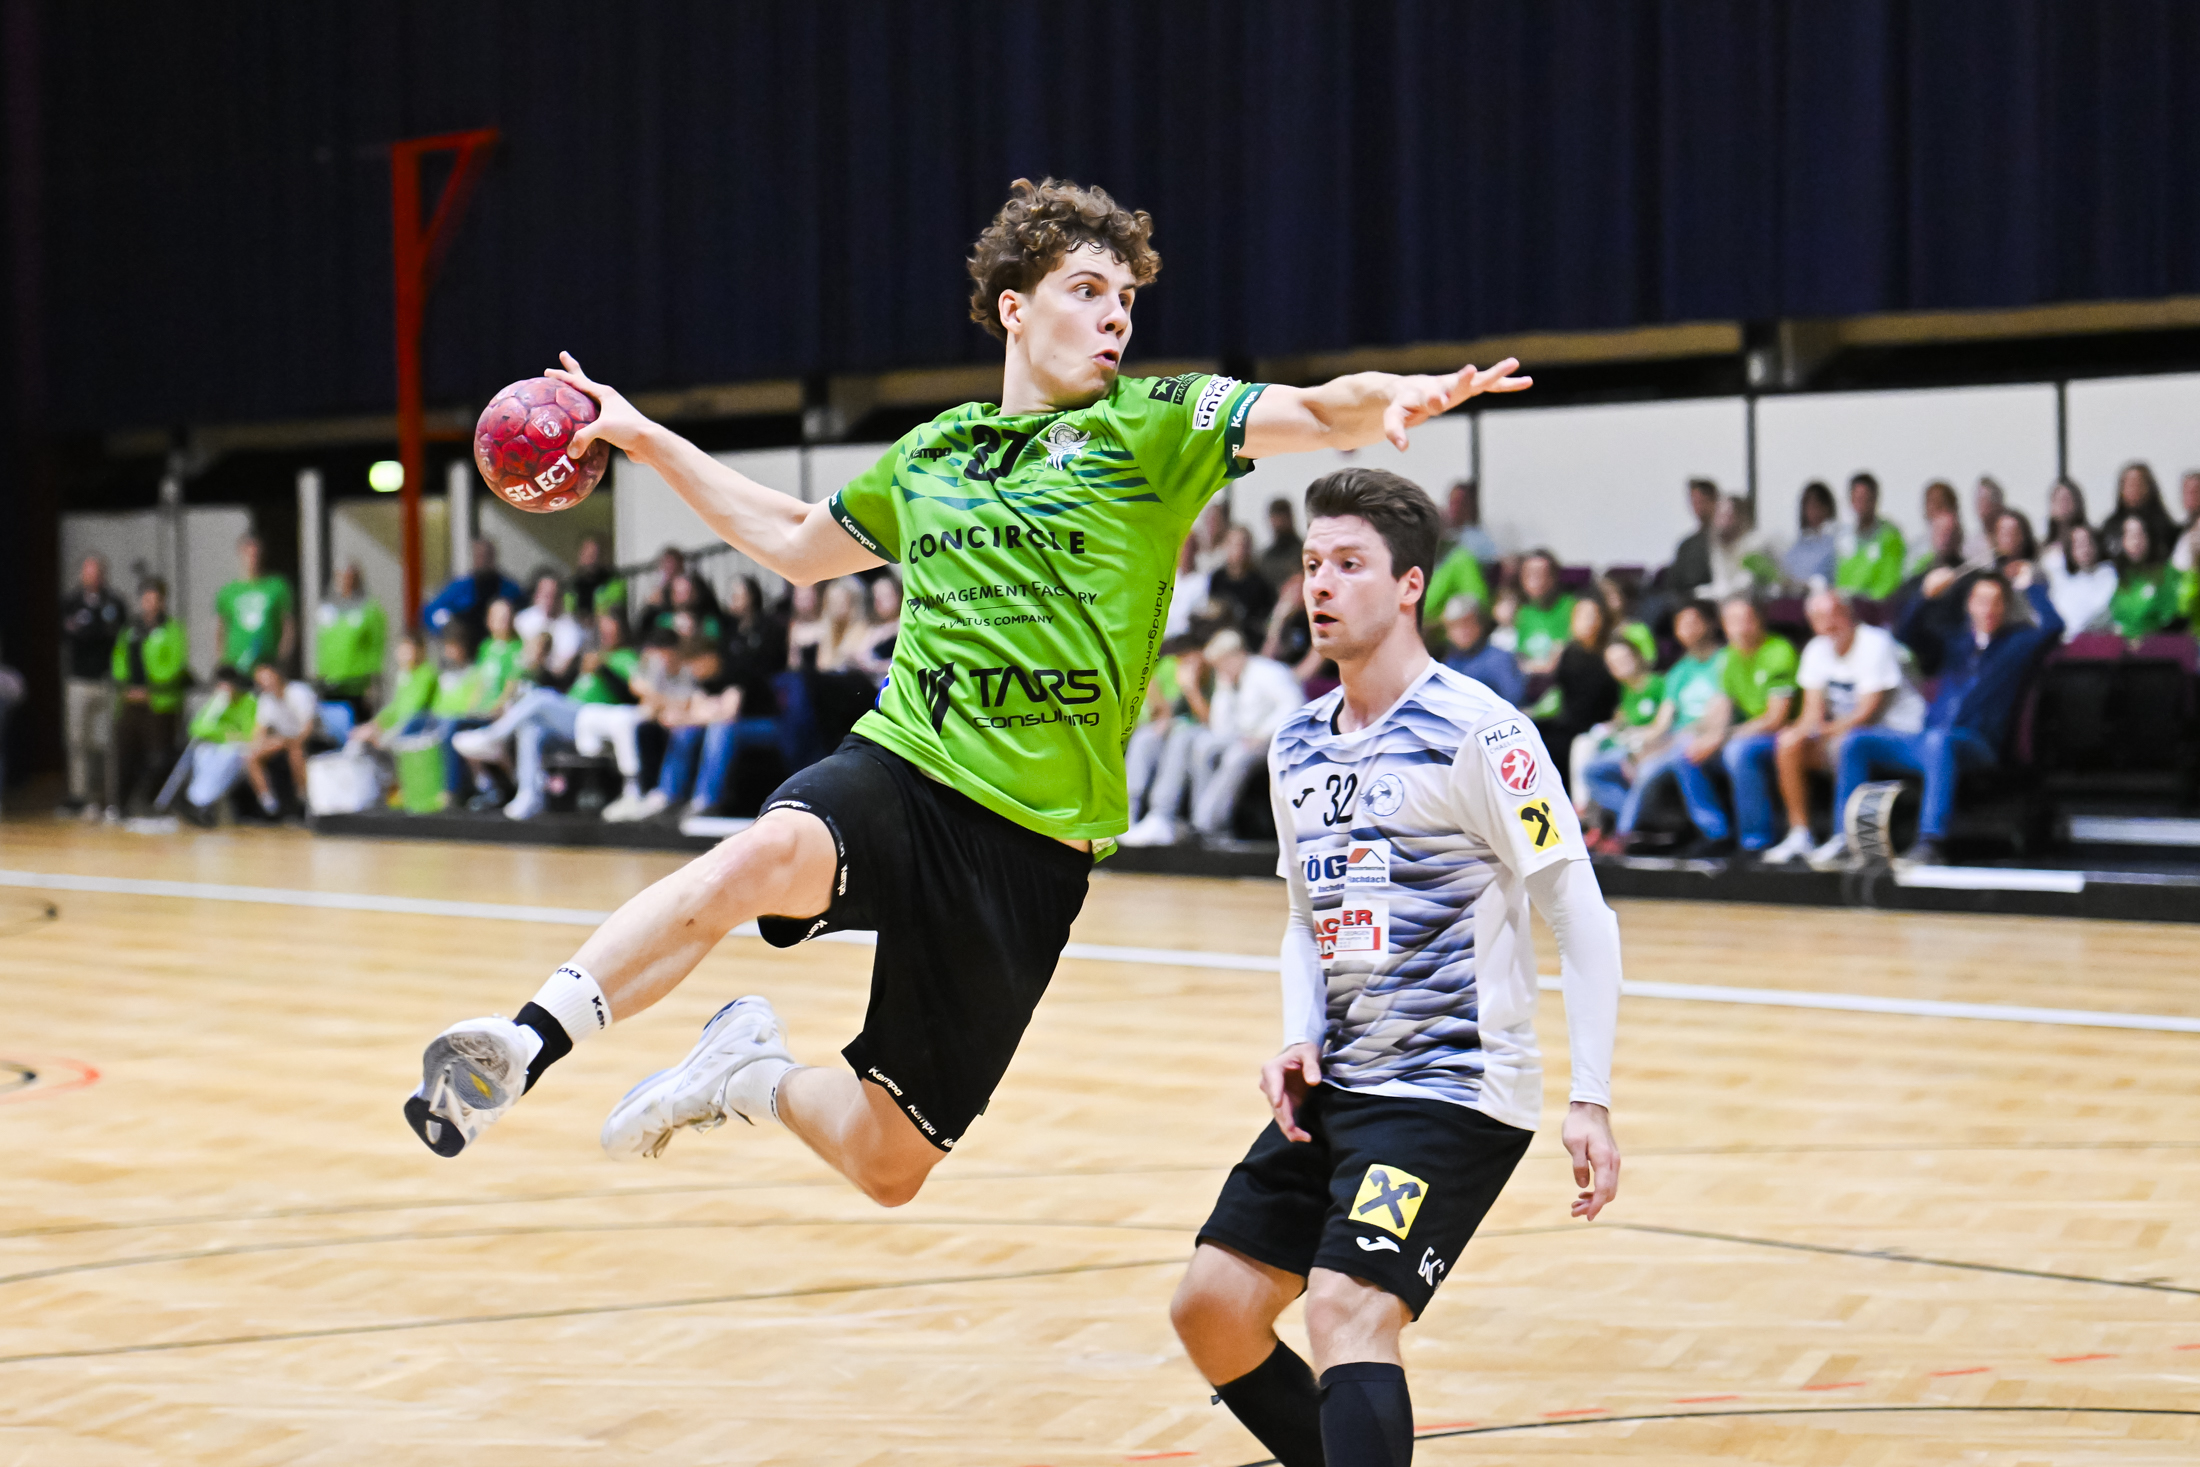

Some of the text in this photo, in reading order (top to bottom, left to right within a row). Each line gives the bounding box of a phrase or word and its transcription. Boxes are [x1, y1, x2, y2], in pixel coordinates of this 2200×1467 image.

[1230, 391, 1259, 428] Kempa
[907, 447, 953, 463] Kempa
[505, 454, 575, 502] SELECT
[841, 515, 877, 551] Kempa
[909, 525, 1085, 564] CONCIRCLE
[1032, 581, 1097, 606] FACRY
[994, 615, 1054, 627] COMPANY
[1138, 580, 1167, 692] management
[969, 665, 1101, 707] TARS
[1485, 725, 1521, 746] HLA
[1323, 773, 1358, 827] 32
[868, 1066, 904, 1097] Kempa
